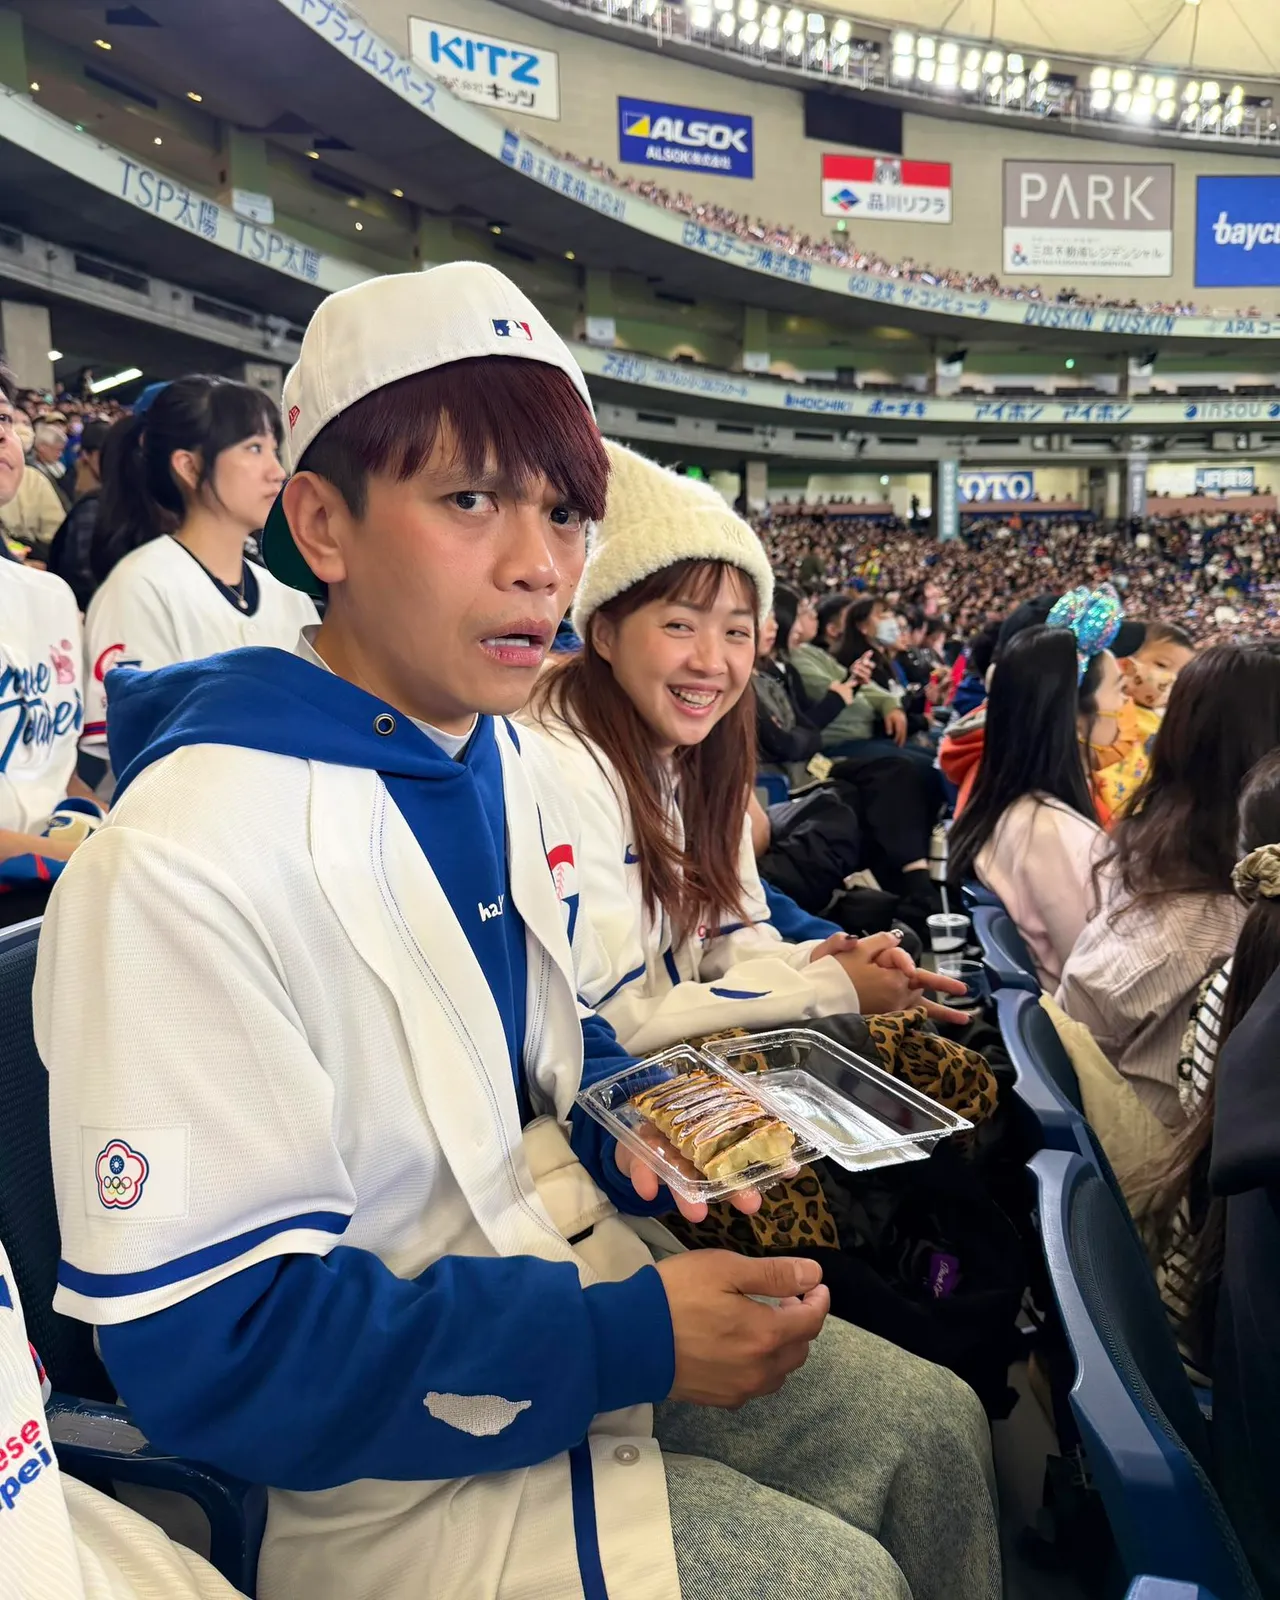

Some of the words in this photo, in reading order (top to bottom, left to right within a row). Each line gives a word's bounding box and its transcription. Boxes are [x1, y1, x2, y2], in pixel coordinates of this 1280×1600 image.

[429, 30, 540, 86] KITZ
[650, 116, 748, 153] ALSOK
[118, 156, 220, 240] TSP太陽
[867, 192, 946, 216] 品川リフラ
[1020, 172, 1156, 221] PARK
[236, 219, 324, 281] TSP太陽
[1024, 303, 1096, 328] DUSKIN
[1102, 311, 1176, 335] DUSKIN
[974, 401, 1045, 421] アイホン
[1061, 401, 1134, 421] アイホン
